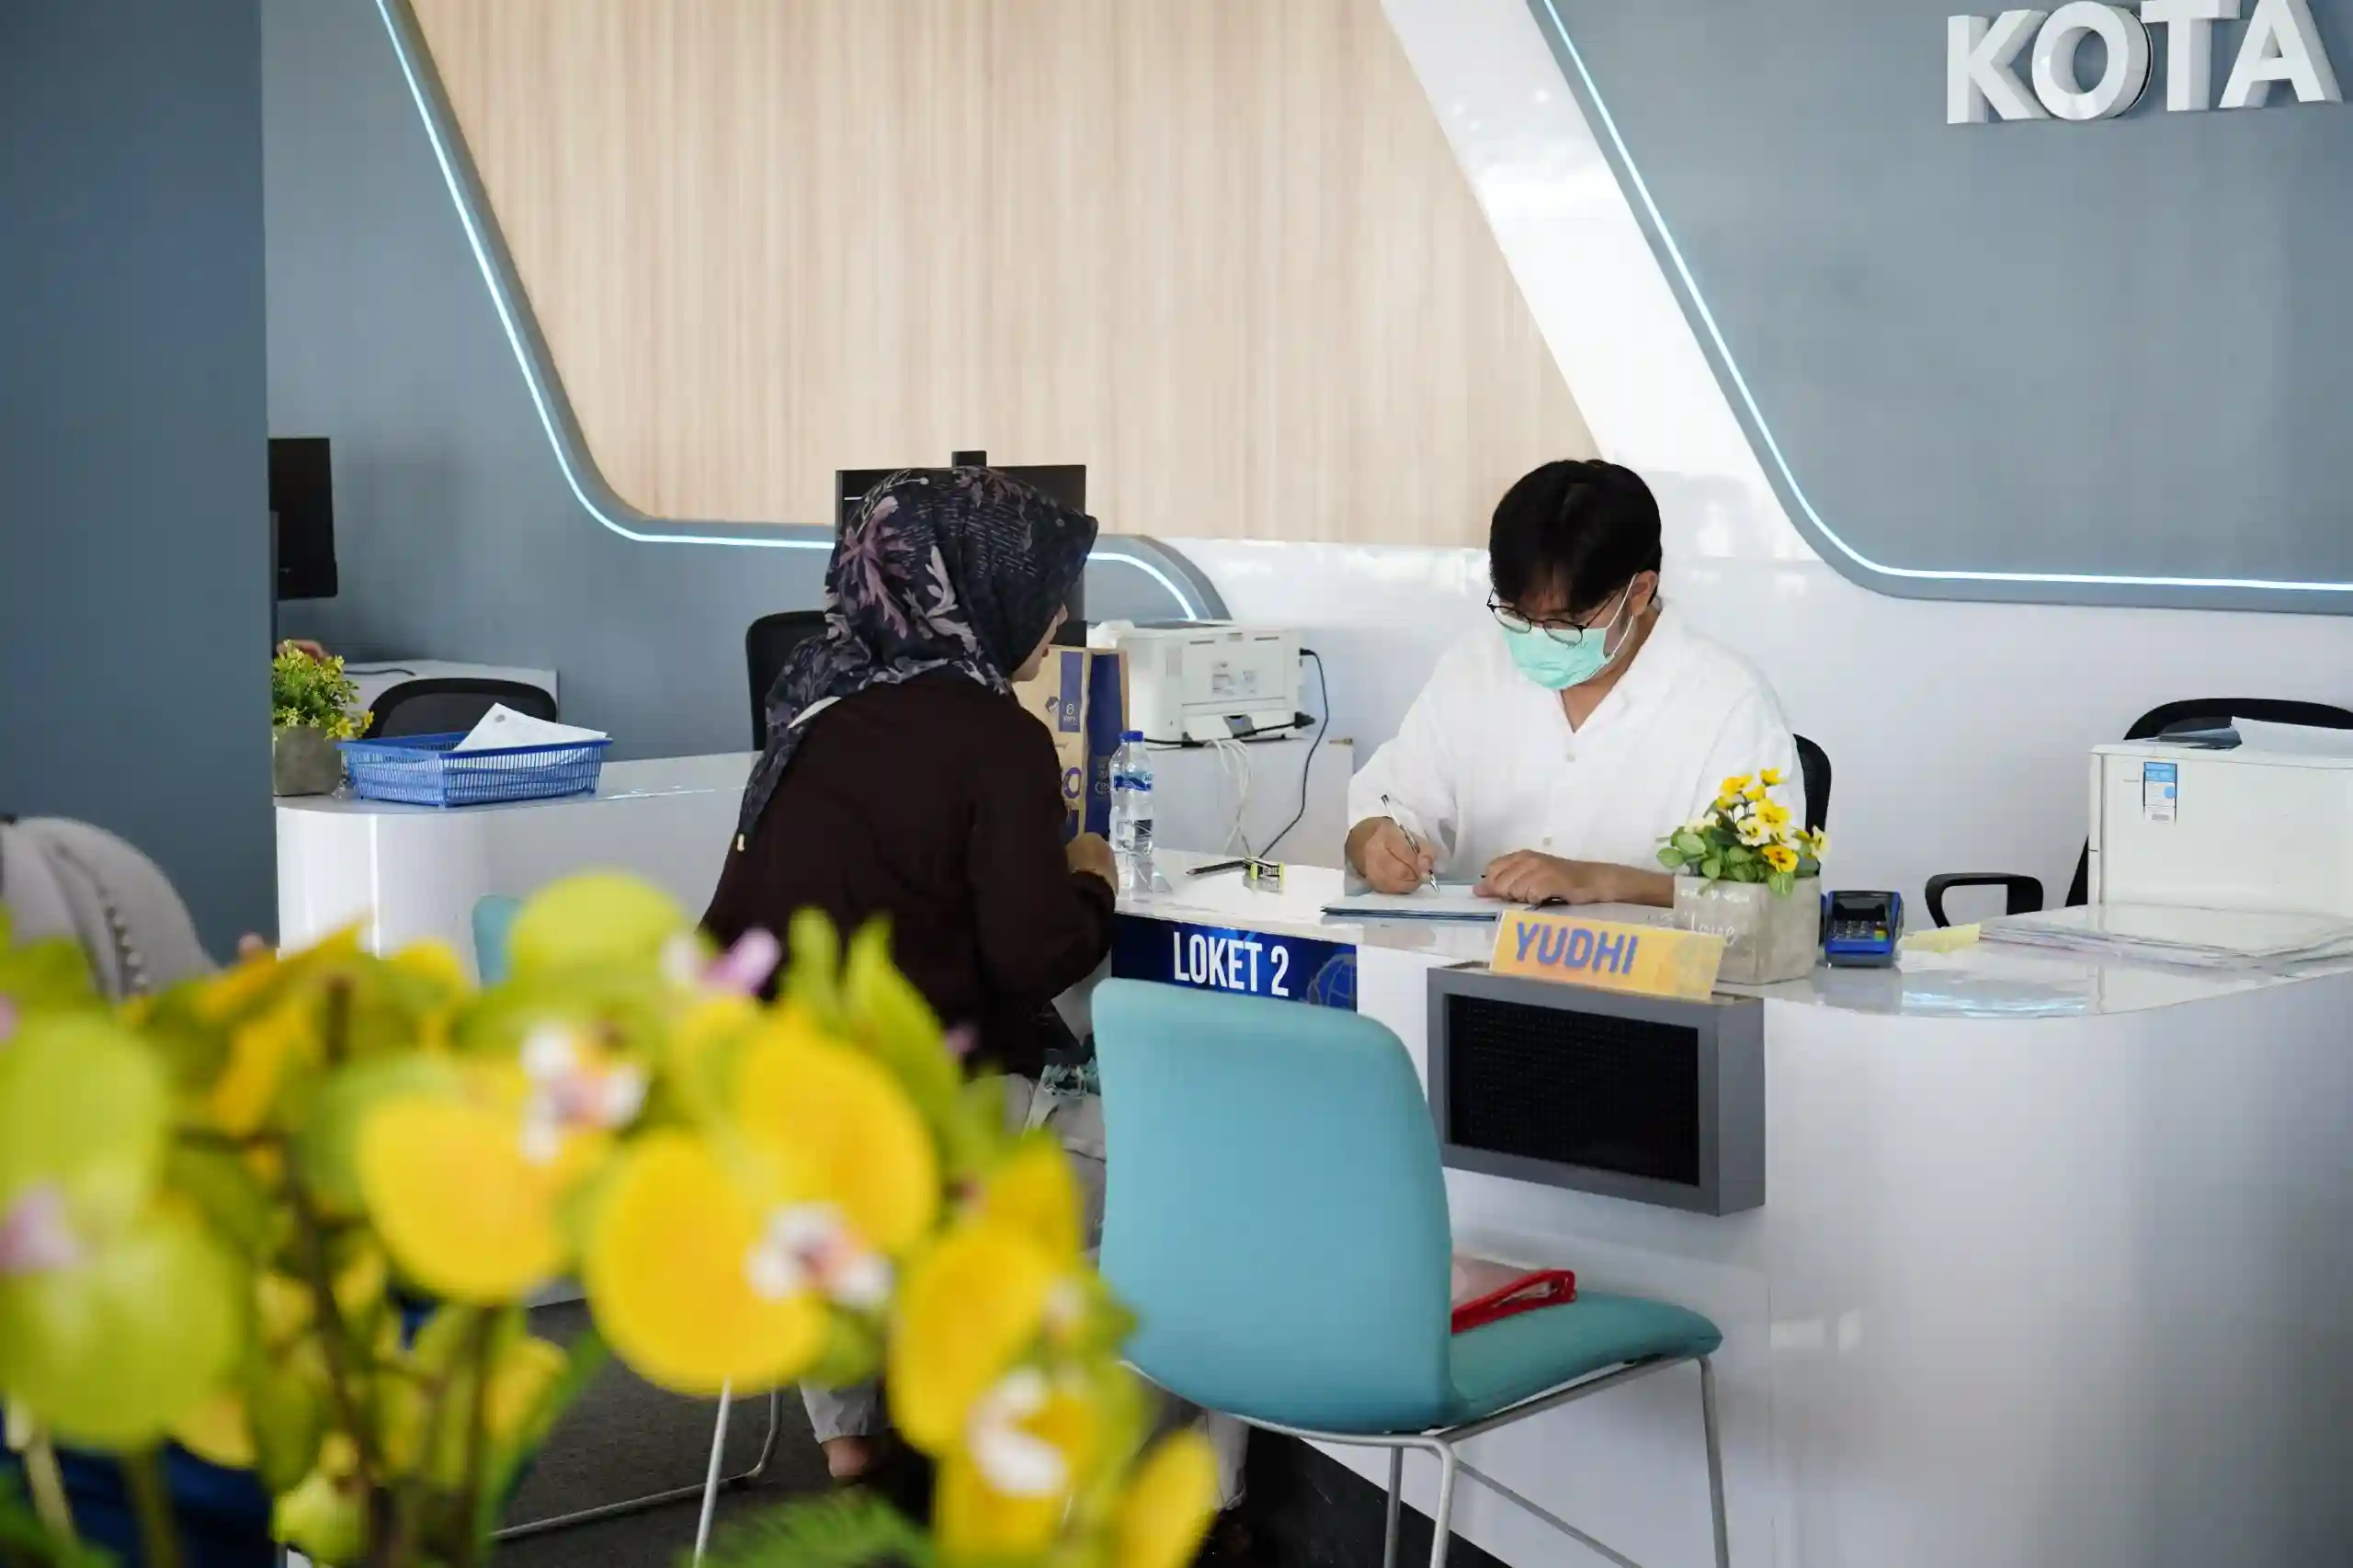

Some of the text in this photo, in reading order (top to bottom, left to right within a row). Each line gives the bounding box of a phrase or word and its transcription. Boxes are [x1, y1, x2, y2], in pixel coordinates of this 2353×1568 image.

[1947, 0, 2343, 123] KOTA
[1173, 931, 1290, 997] LOKET 2
[1517, 922, 1639, 975] YUDHI
